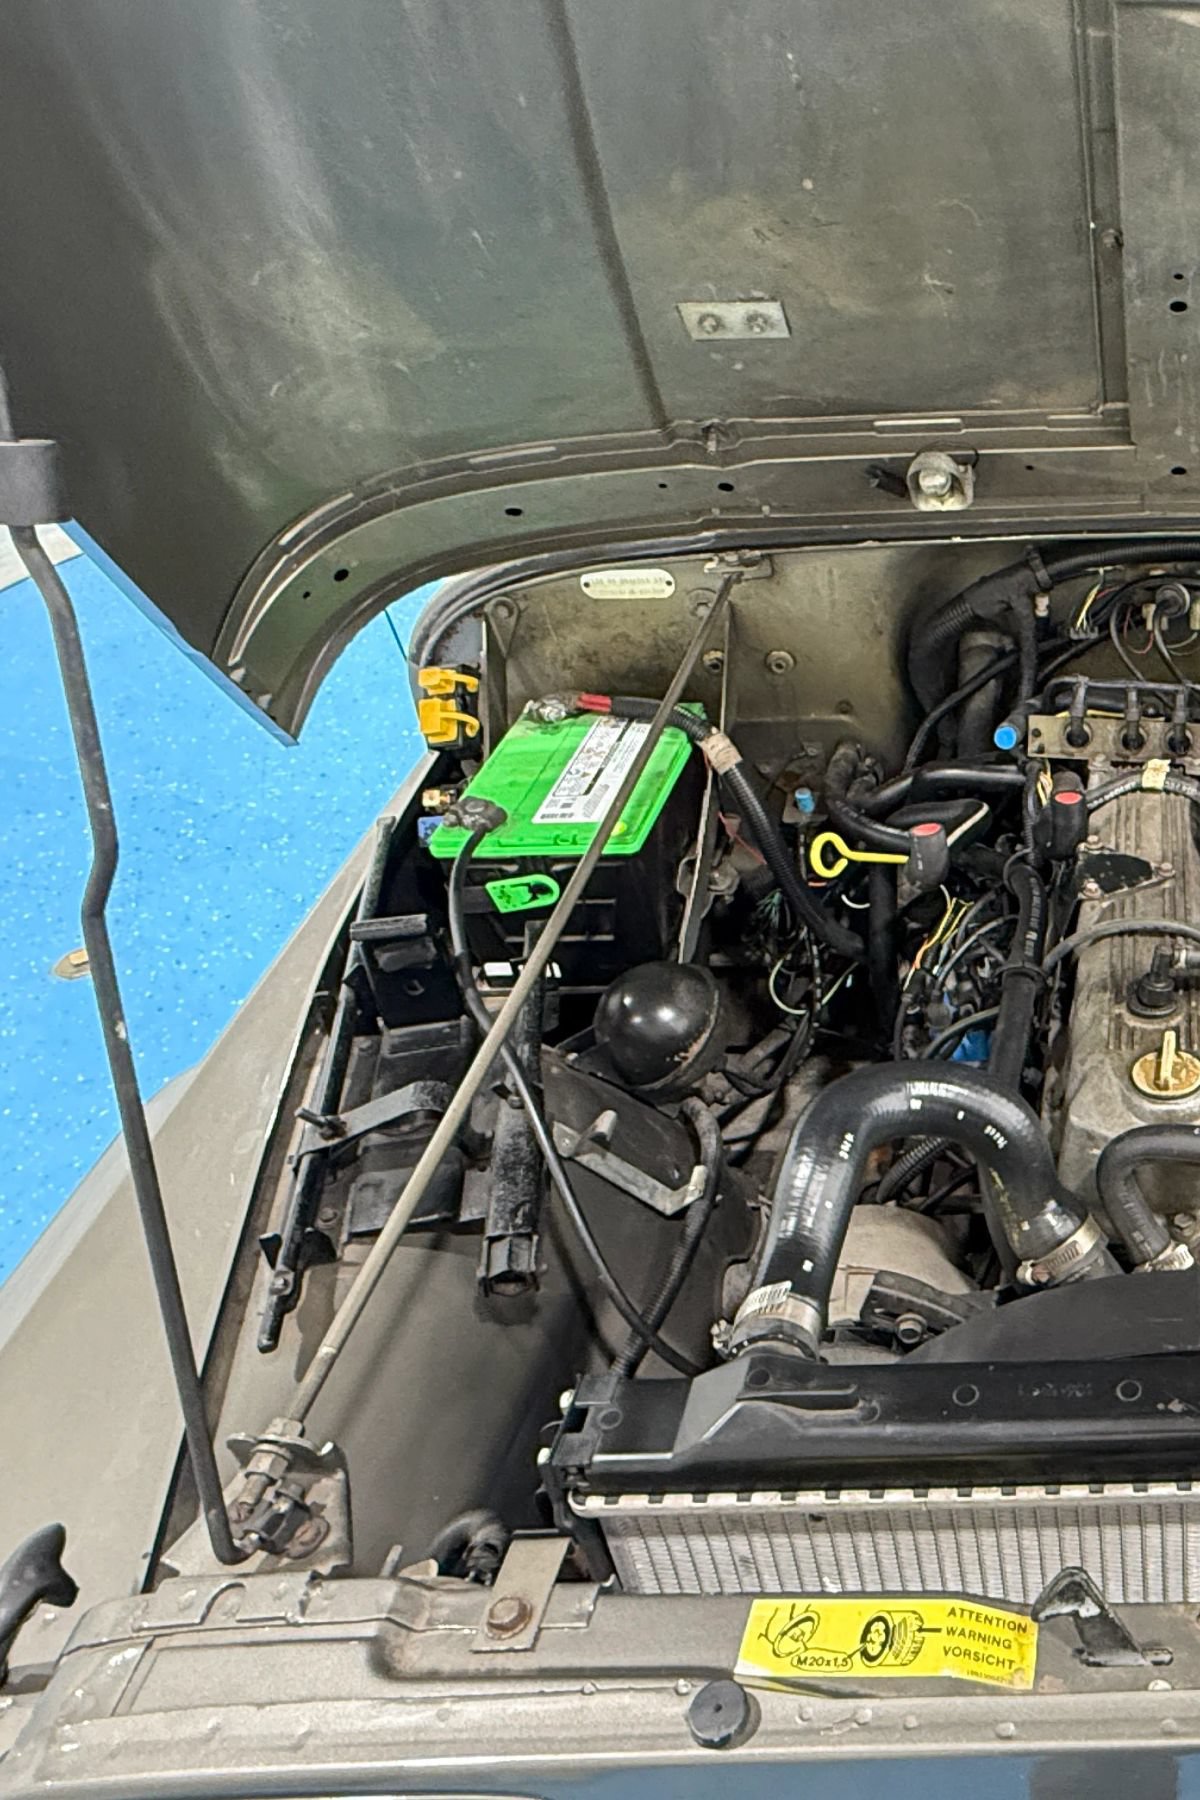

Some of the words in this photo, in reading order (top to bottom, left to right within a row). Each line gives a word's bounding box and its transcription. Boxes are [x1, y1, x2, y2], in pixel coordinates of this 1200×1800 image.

[947, 1606, 1028, 1634] ATTENTION
[946, 1626, 1013, 1650] WARNING
[943, 1645, 1016, 1670] VORSICHT
